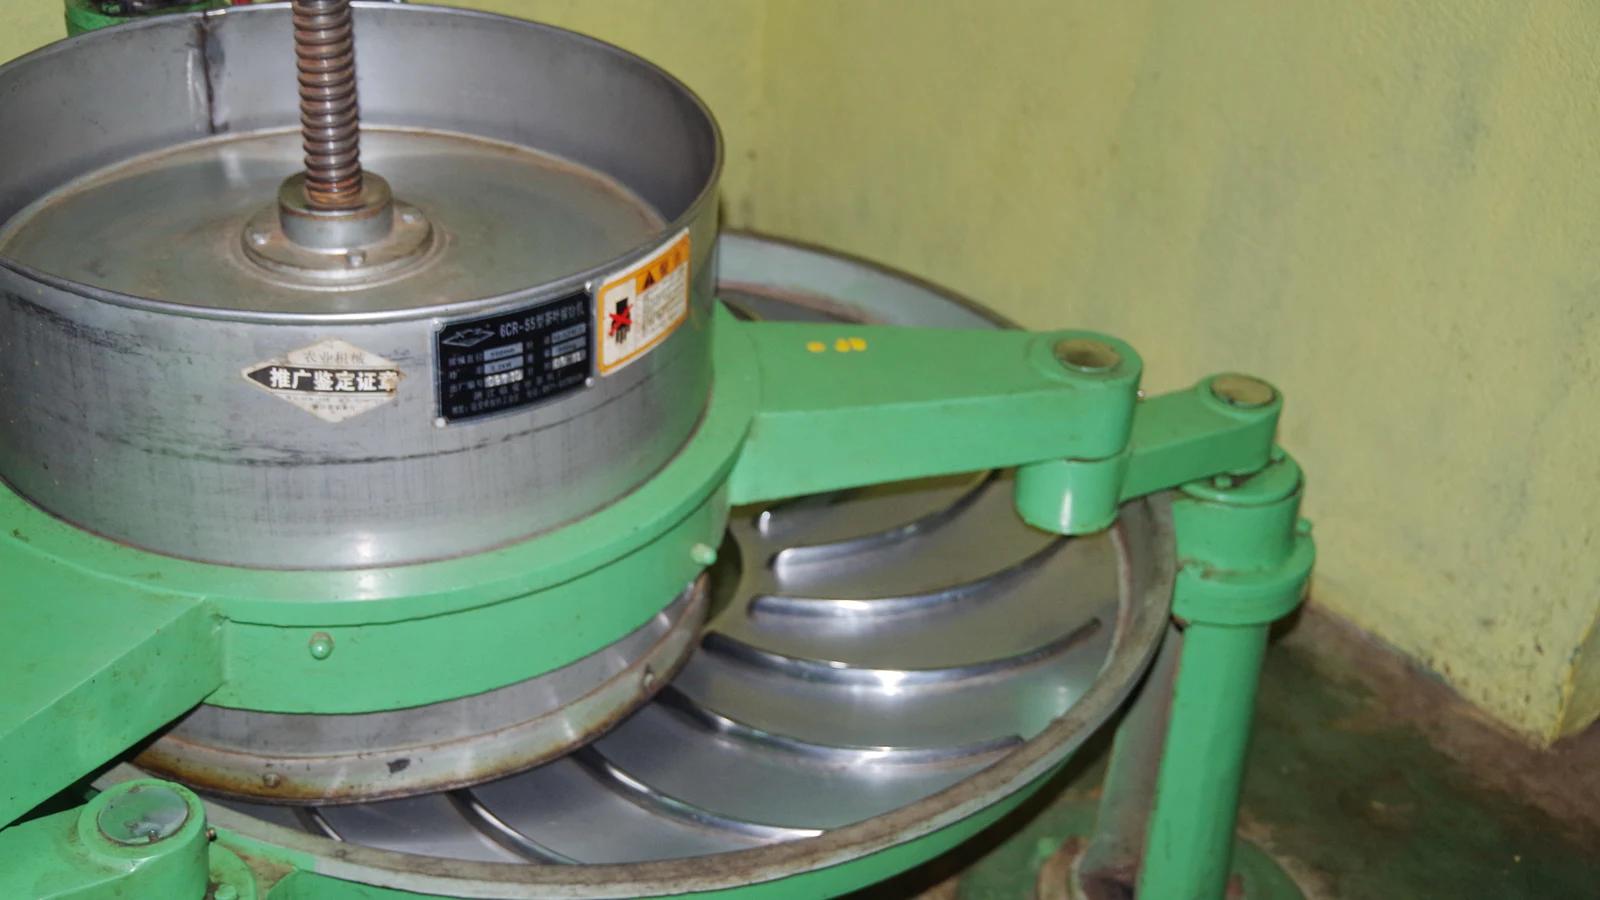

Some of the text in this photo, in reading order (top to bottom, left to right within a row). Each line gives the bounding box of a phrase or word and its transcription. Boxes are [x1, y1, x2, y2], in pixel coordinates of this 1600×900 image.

[304, 351, 366, 364] 农业机械
[269, 367, 399, 391] 推广鉴定证章
